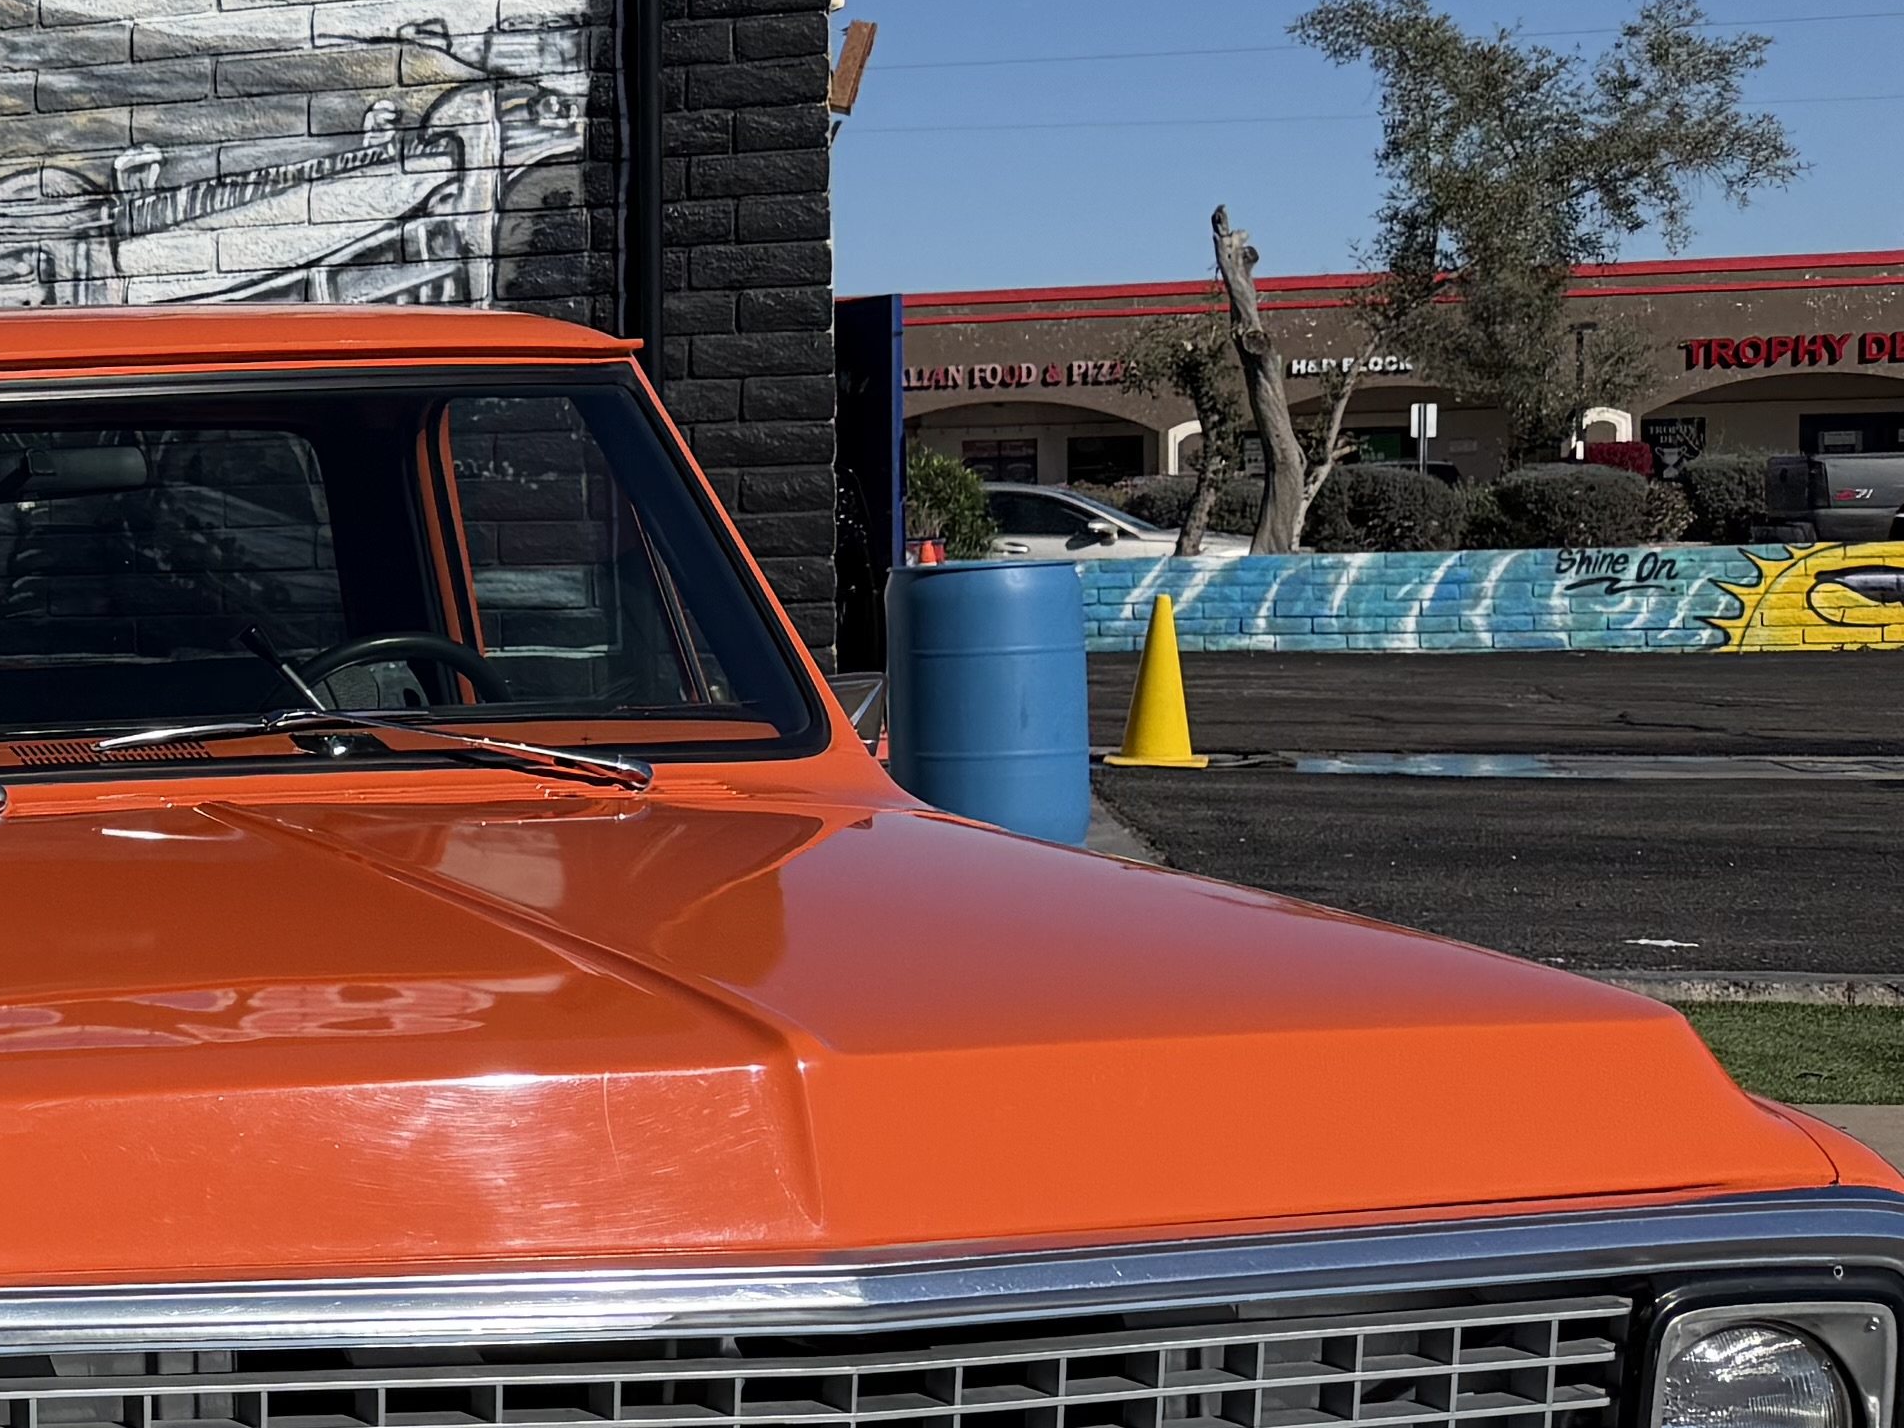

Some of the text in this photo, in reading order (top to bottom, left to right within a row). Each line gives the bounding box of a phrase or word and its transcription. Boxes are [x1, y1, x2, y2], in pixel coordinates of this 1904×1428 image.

[1686, 333, 1853, 368] TROPHY
[969, 362, 1038, 387] FOOD
[1044, 362, 1063, 384] &
[1555, 548, 1679, 583] Shine On
